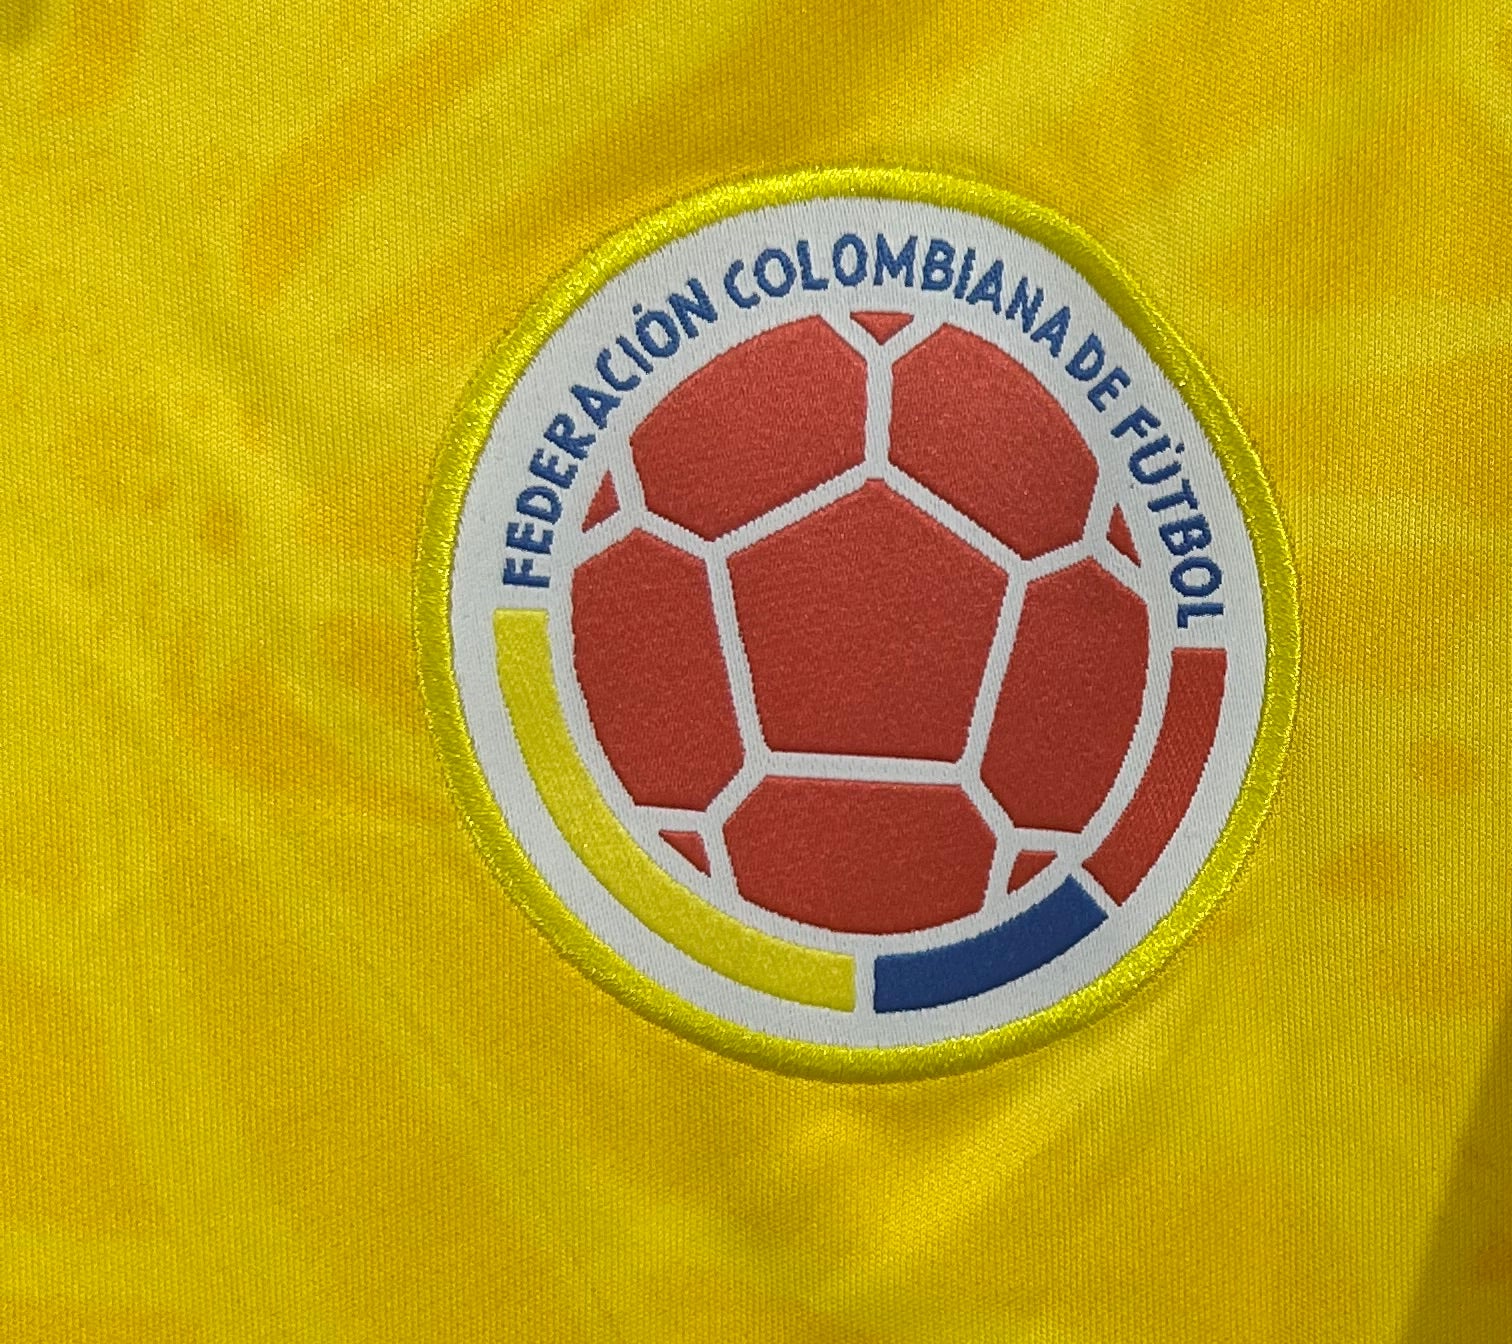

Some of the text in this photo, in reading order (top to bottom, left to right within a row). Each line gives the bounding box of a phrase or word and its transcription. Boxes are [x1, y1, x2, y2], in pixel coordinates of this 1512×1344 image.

[502, 232, 1225, 630] FEDERACIÓN COLOMBIANA DE FÚTBOL
